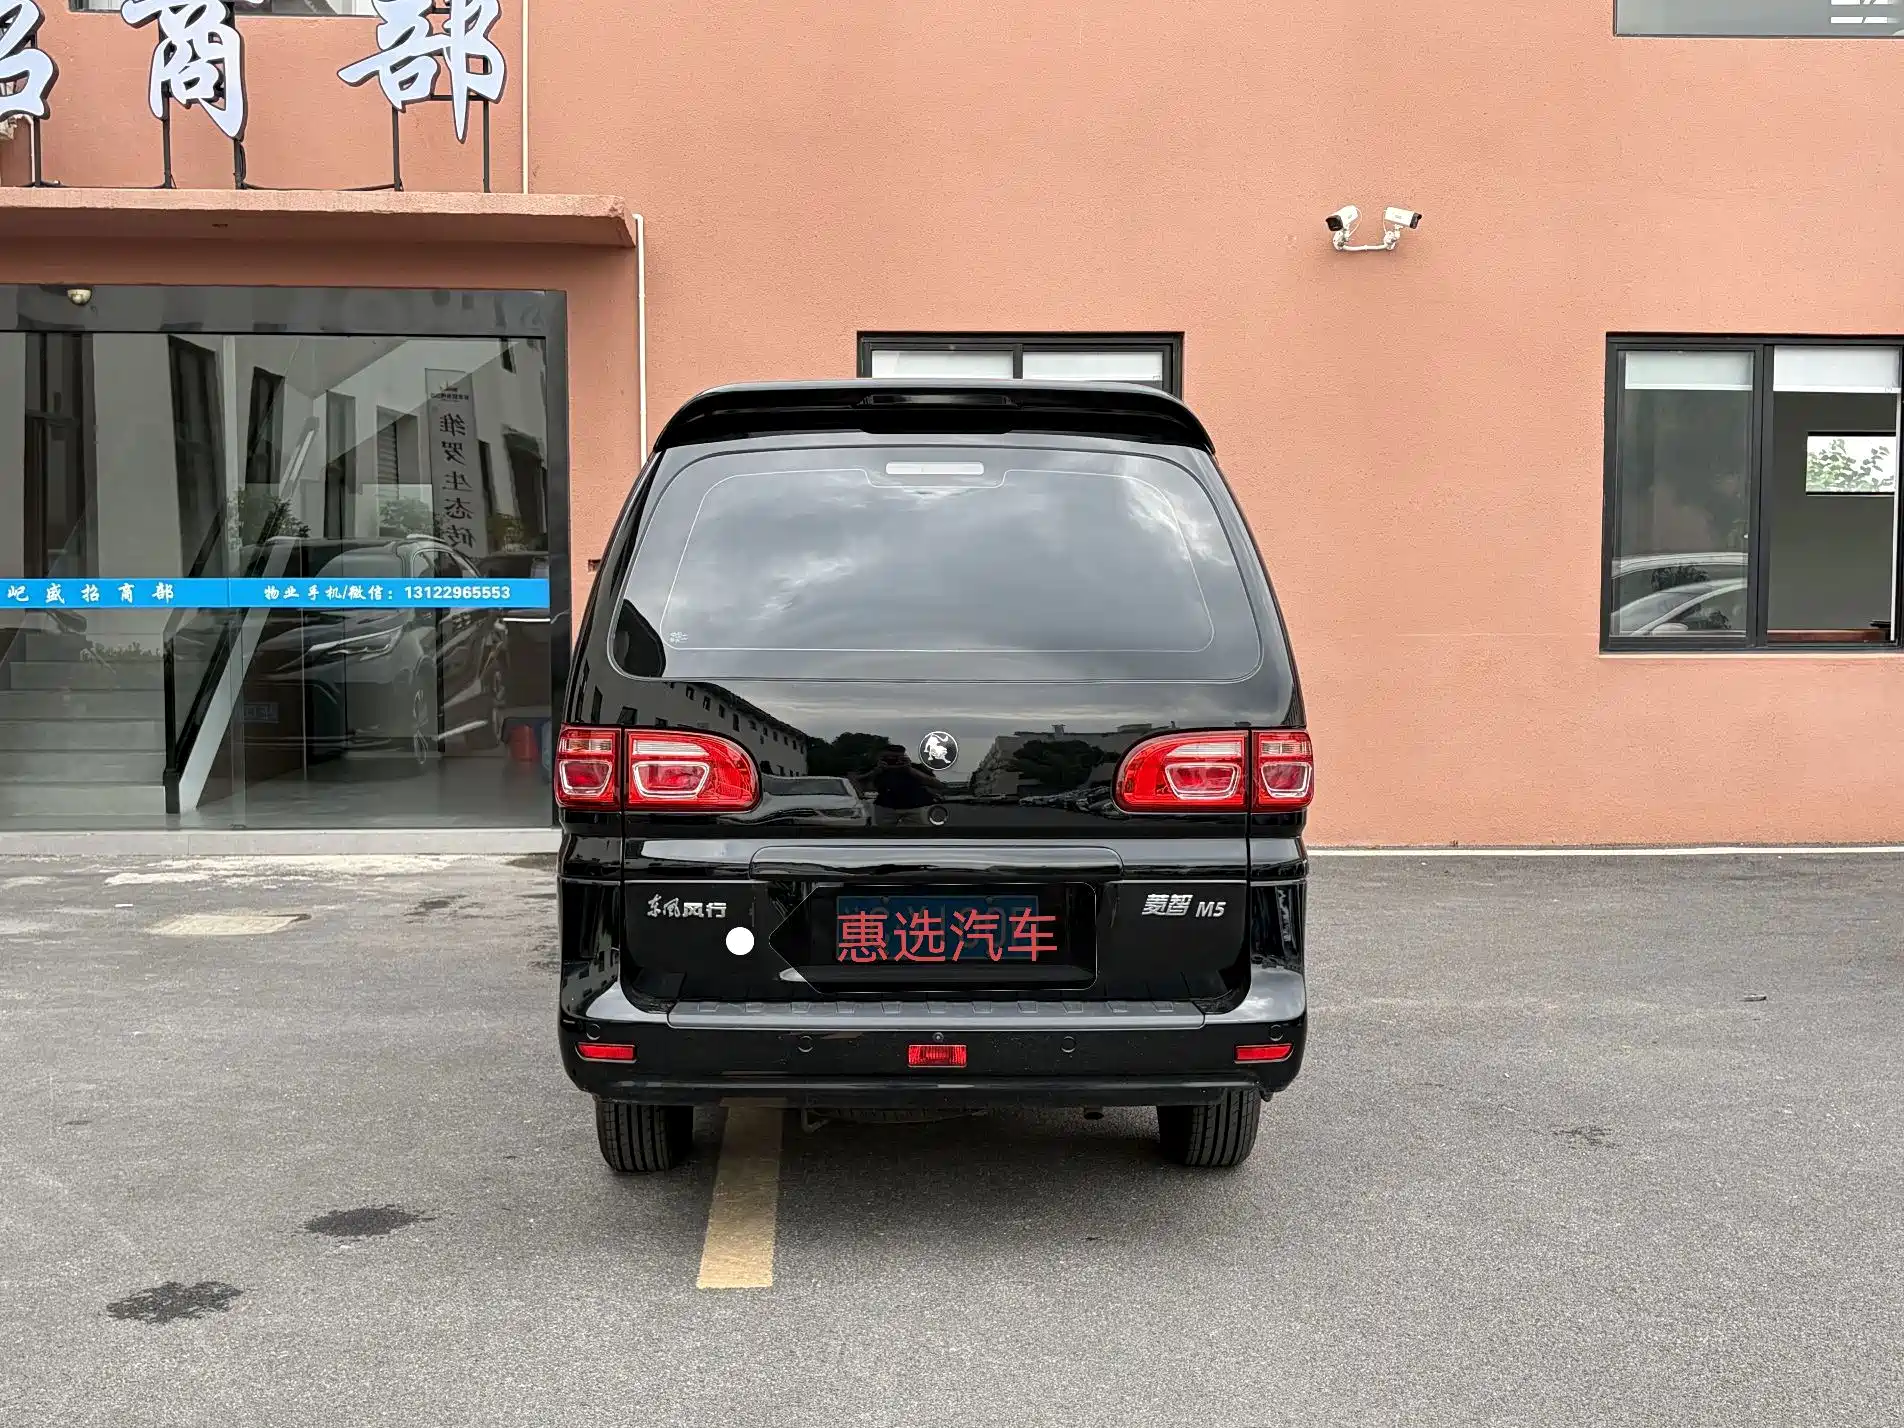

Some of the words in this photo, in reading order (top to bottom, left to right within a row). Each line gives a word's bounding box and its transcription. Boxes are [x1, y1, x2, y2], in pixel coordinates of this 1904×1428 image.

[404, 586, 511, 599] 13122965553
[1141, 894, 1194, 916] 菱智
[1195, 901, 1227, 918] M5
